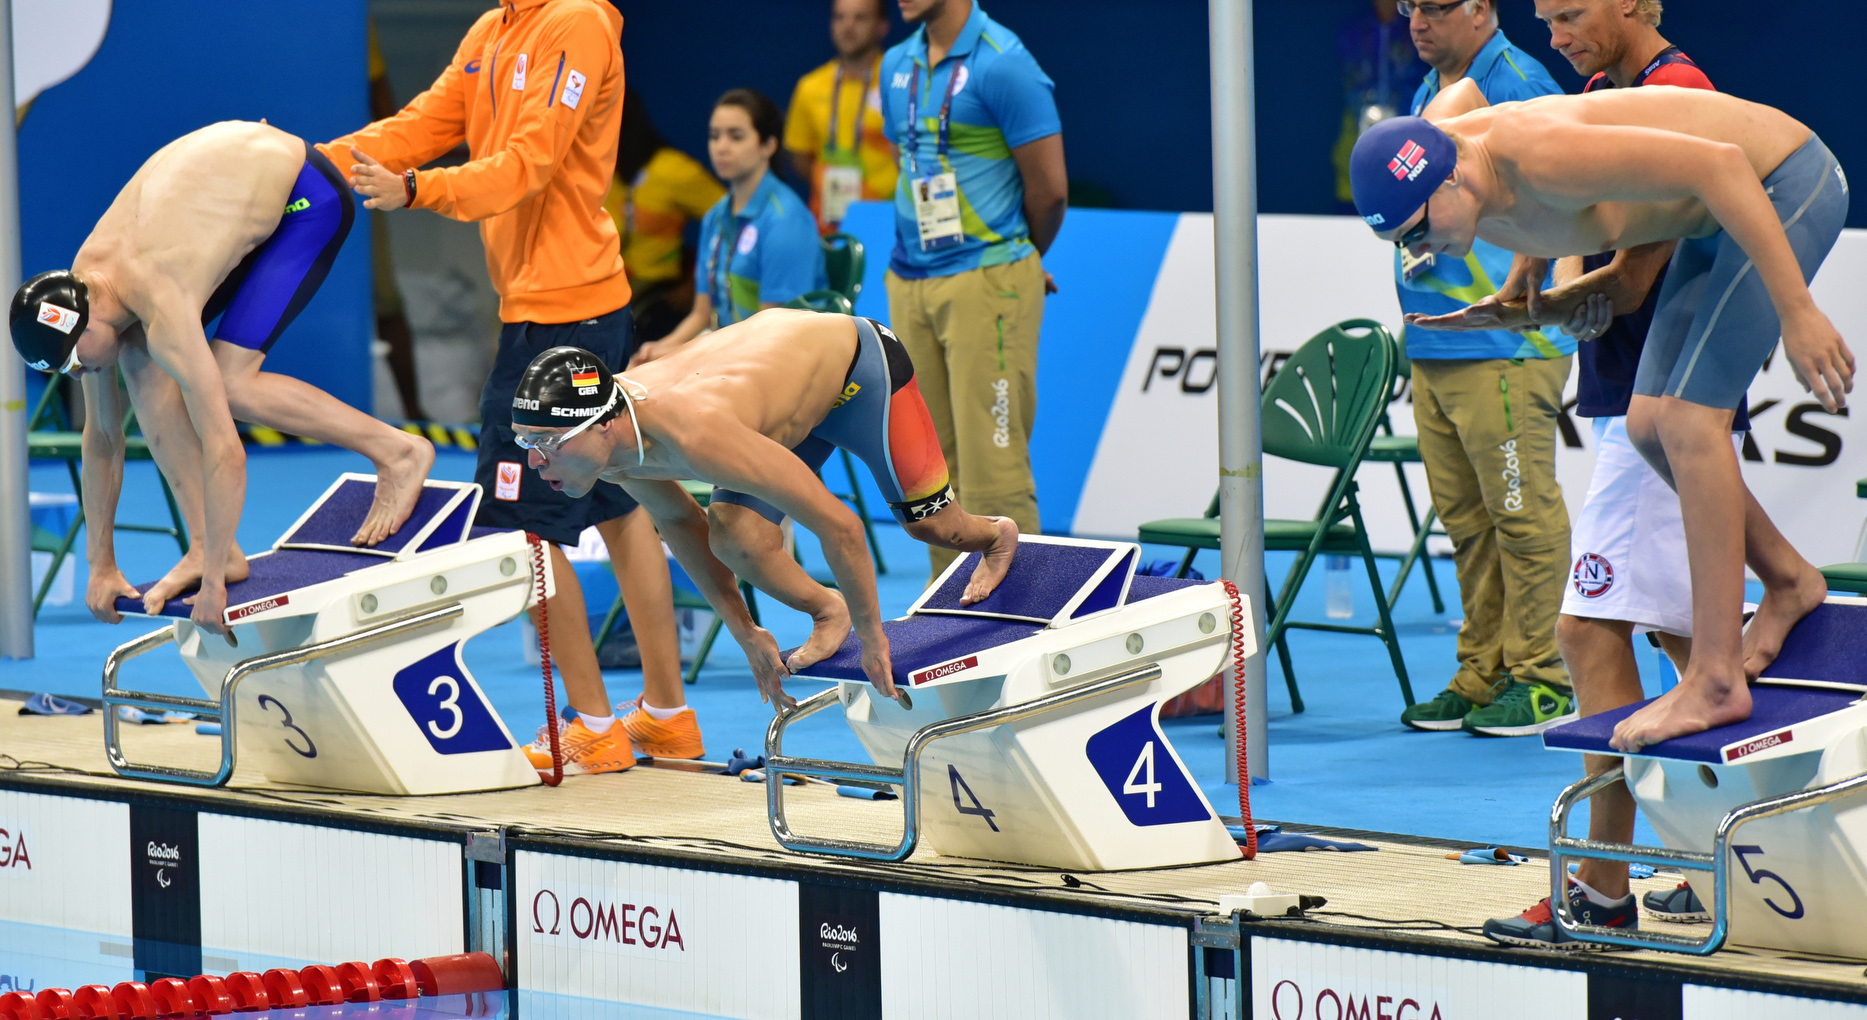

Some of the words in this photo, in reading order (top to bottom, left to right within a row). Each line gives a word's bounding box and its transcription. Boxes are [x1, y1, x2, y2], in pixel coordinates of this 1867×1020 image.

[1407, 158, 1429, 182] NOR
[578, 386, 598, 396] GER
[991, 378, 1010, 448] Rio2016
[1499, 439, 1523, 512] Rio2016
[248, 600, 279, 615] OMEGA
[935, 661, 967, 678] OMEGA
[258, 694, 317, 759] 3
[427, 675, 463, 739] 3
[1748, 735, 1782, 753] OMEGA
[947, 764, 1001, 833] 4
[1123, 740, 1162, 808] 4
[147, 841, 180, 860] Rio2016
[1732, 844, 1804, 920] 5
[570, 897, 685, 952] OMEGA
[820, 922, 857, 943] Rio2016
